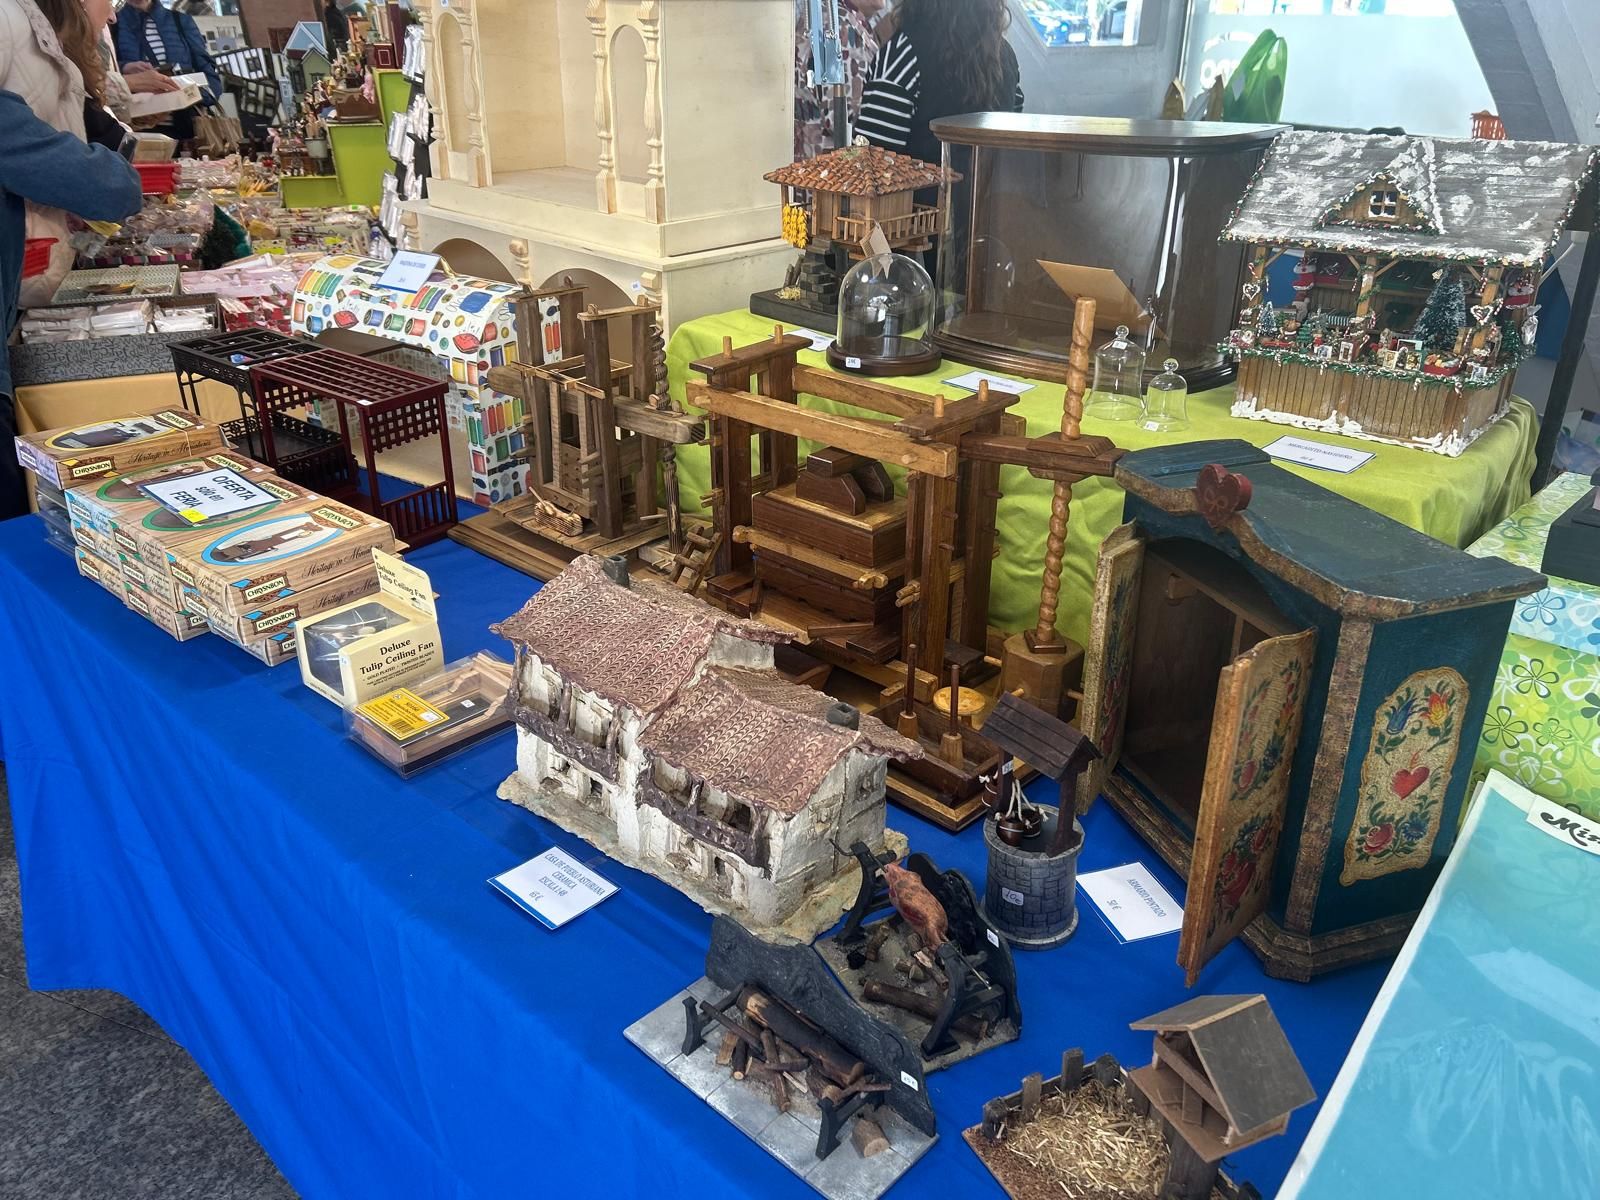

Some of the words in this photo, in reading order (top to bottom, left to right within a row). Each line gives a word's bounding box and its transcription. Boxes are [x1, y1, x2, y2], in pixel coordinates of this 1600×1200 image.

[74, 462, 111, 476] CHRYSNBON
[212, 475, 257, 501] OFERTA
[170, 491, 204, 508] FERIA
[208, 493, 225, 502] en
[317, 508, 355, 527] CHRYSNBON
[301, 561, 335, 578] Heritage
[247, 580, 284, 597] CHRYSNBON
[313, 592, 346, 609] Heritage
[258, 611, 294, 629] CHRYSNBON
[379, 639, 411, 656] Deluxe
[360, 662, 383, 675] Tulip
[385, 648, 416, 665] Ceiling
[418, 641, 434, 652] Fan
[545, 853, 559, 866] CASA
[579, 876, 606, 896] ASTURIANA
[538, 875, 559, 892] ESCALA
[1126, 878, 1150, 898] ARMARIO
[1143, 897, 1167, 917] PINTADO
